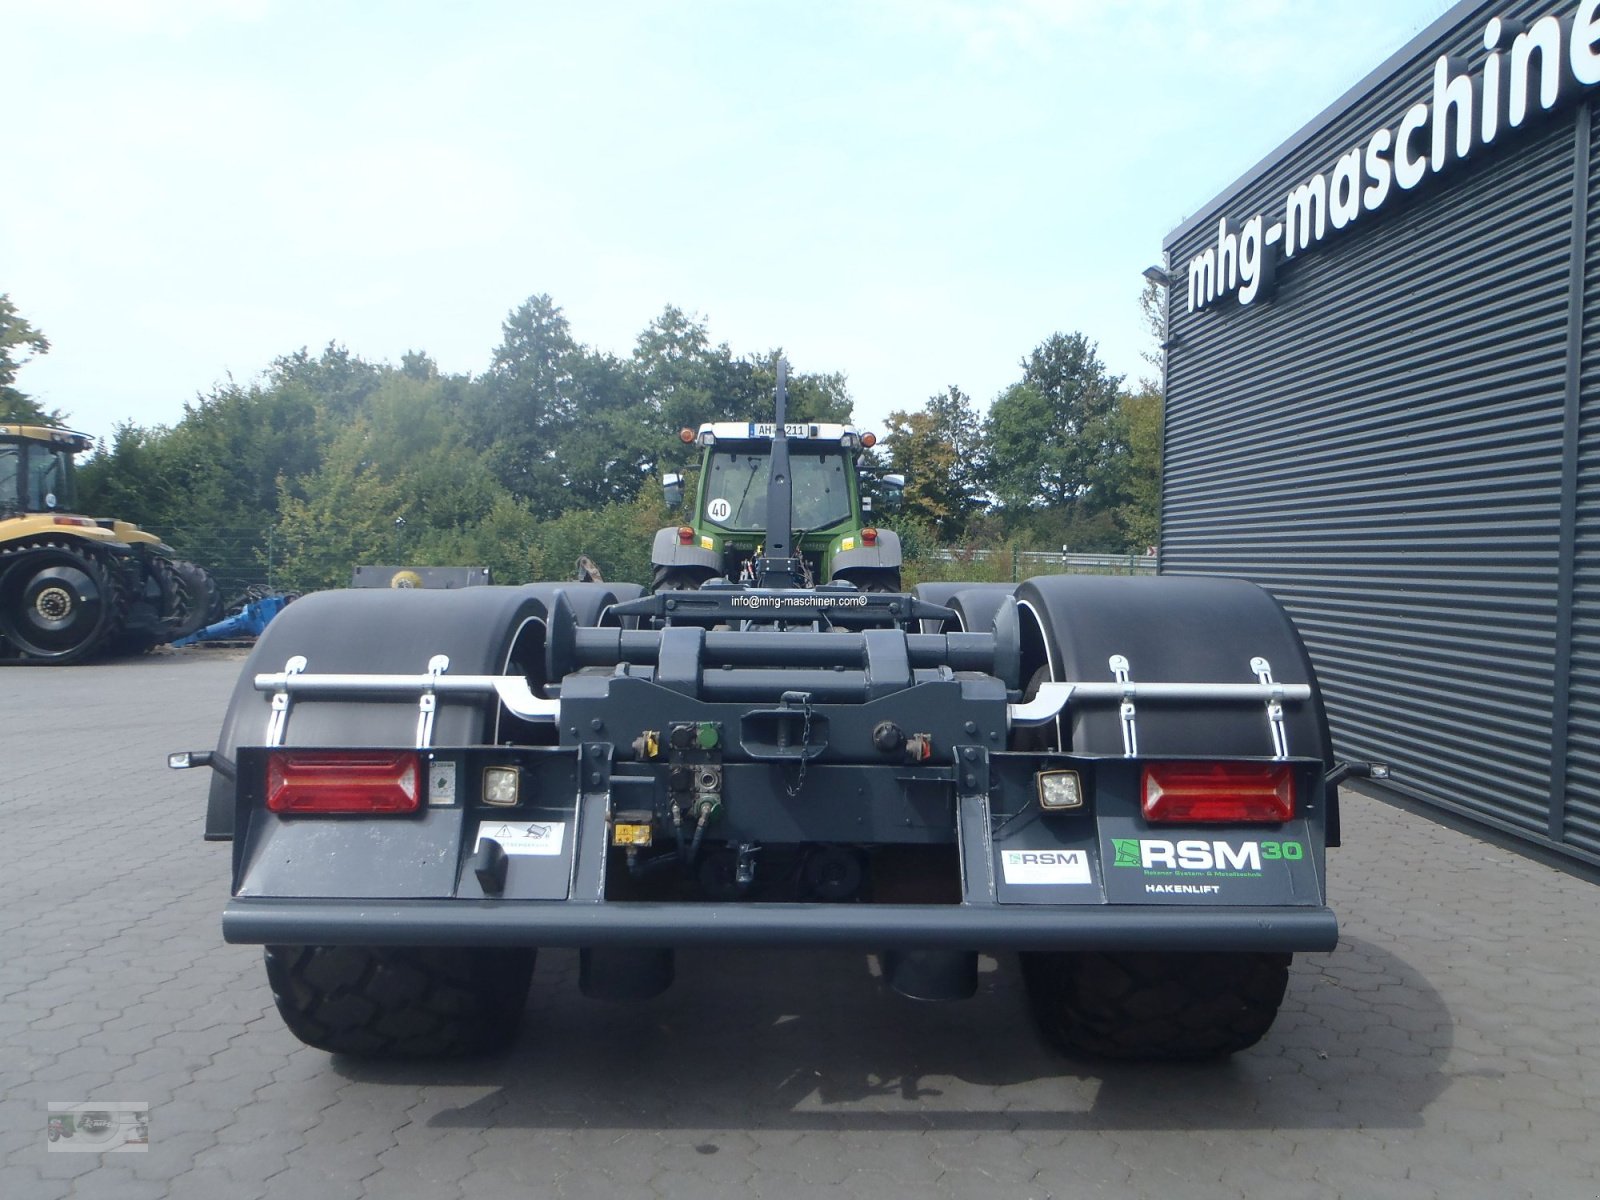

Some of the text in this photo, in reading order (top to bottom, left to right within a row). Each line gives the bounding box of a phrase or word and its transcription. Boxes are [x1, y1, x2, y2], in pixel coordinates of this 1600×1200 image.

[711, 503, 726, 517] 40
[1022, 853, 1079, 865] RSM
[1140, 840, 1303, 870] RSM 30
[1145, 884, 1220, 894] HAKENLIFT
